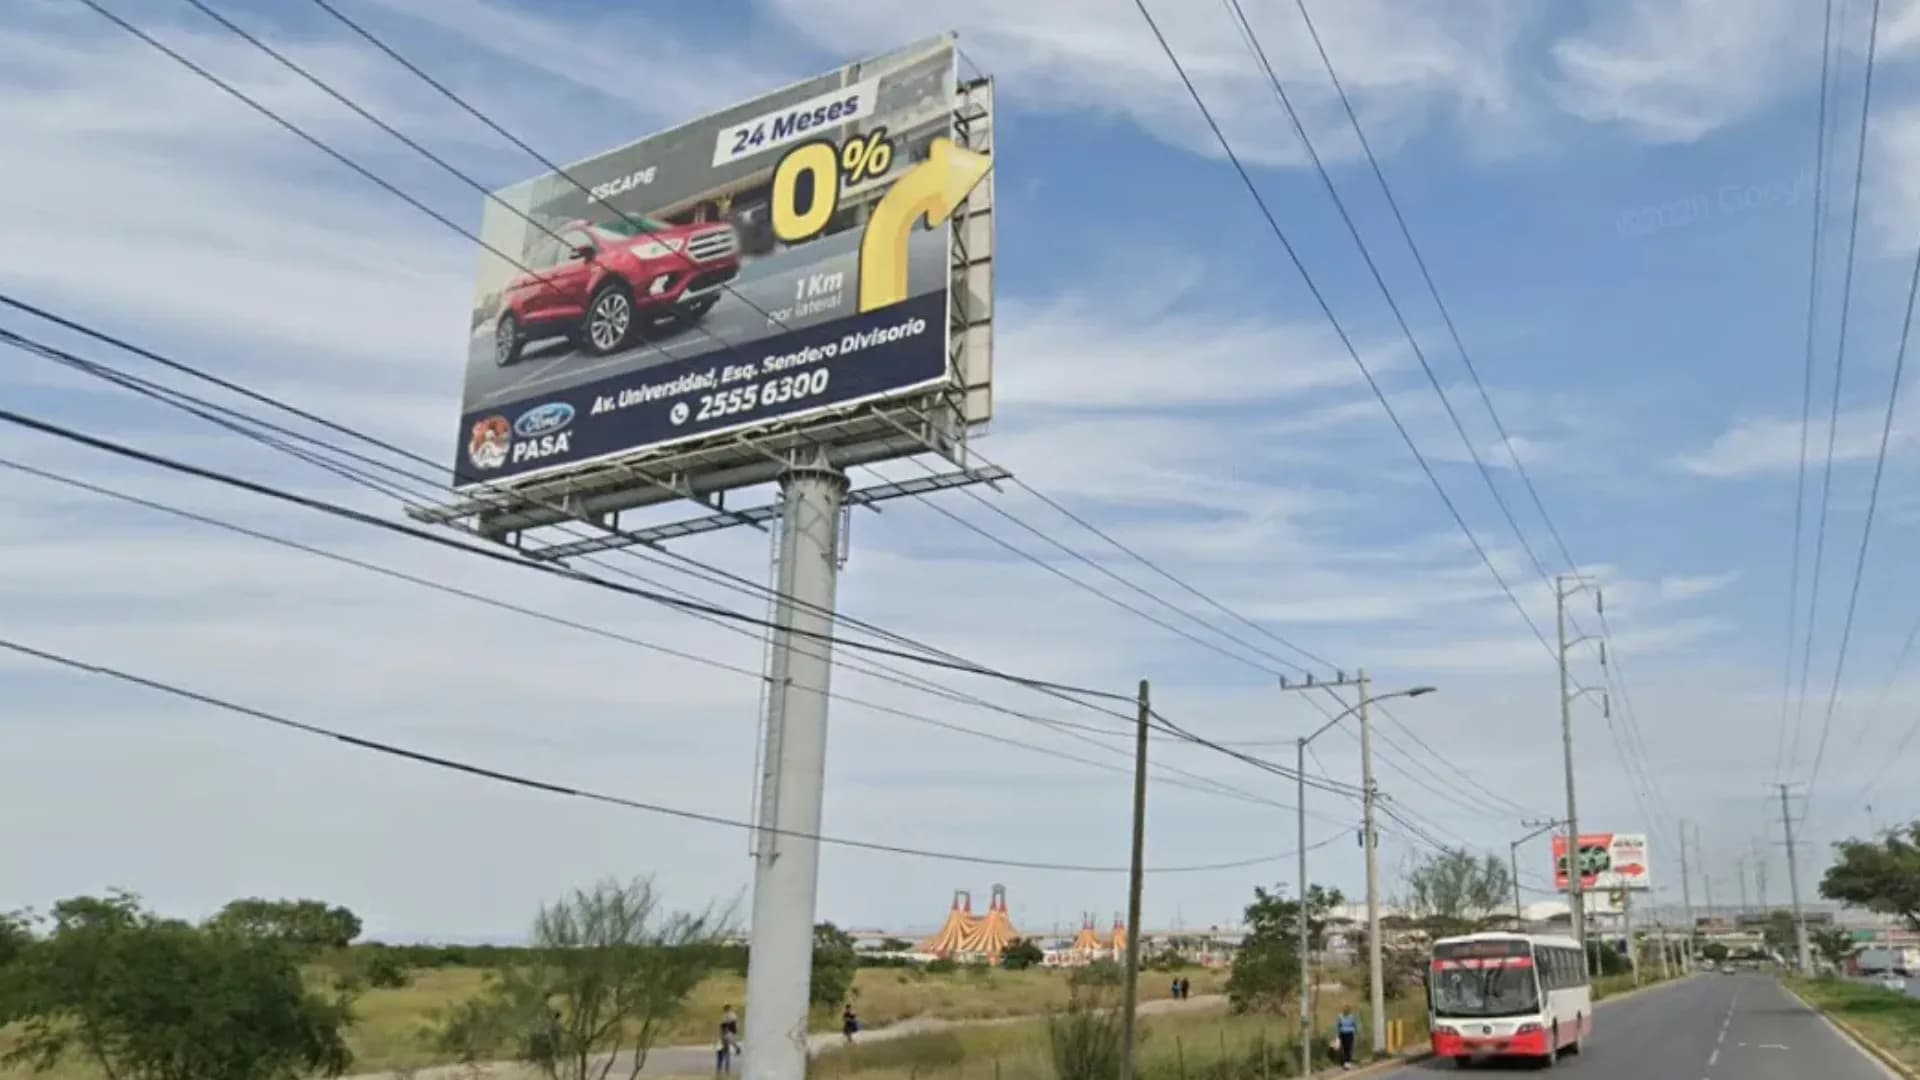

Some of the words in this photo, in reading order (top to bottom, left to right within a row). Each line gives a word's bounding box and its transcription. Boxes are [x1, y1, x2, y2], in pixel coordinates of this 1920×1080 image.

[731, 126, 764, 155] 24
[771, 95, 859, 141] Meses
[588, 166, 657, 203] ESCAPE
[771, 127, 895, 244] 0%
[797, 279, 805, 300] 1
[808, 272, 843, 297] Km
[766, 308, 793, 331] por
[794, 291, 842, 317] lateral
[590, 395, 616, 415] Av.
[618, 368, 718, 407] Universidad,
[721, 363, 759, 384] Esq.
[761, 341, 836, 374] Sendero
[839, 318, 926, 354] Divisorio
[696, 386, 759, 421] 2555
[761, 368, 829, 405] 6300
[518, 405, 567, 433] Ford
[512, 431, 569, 463] PASA
